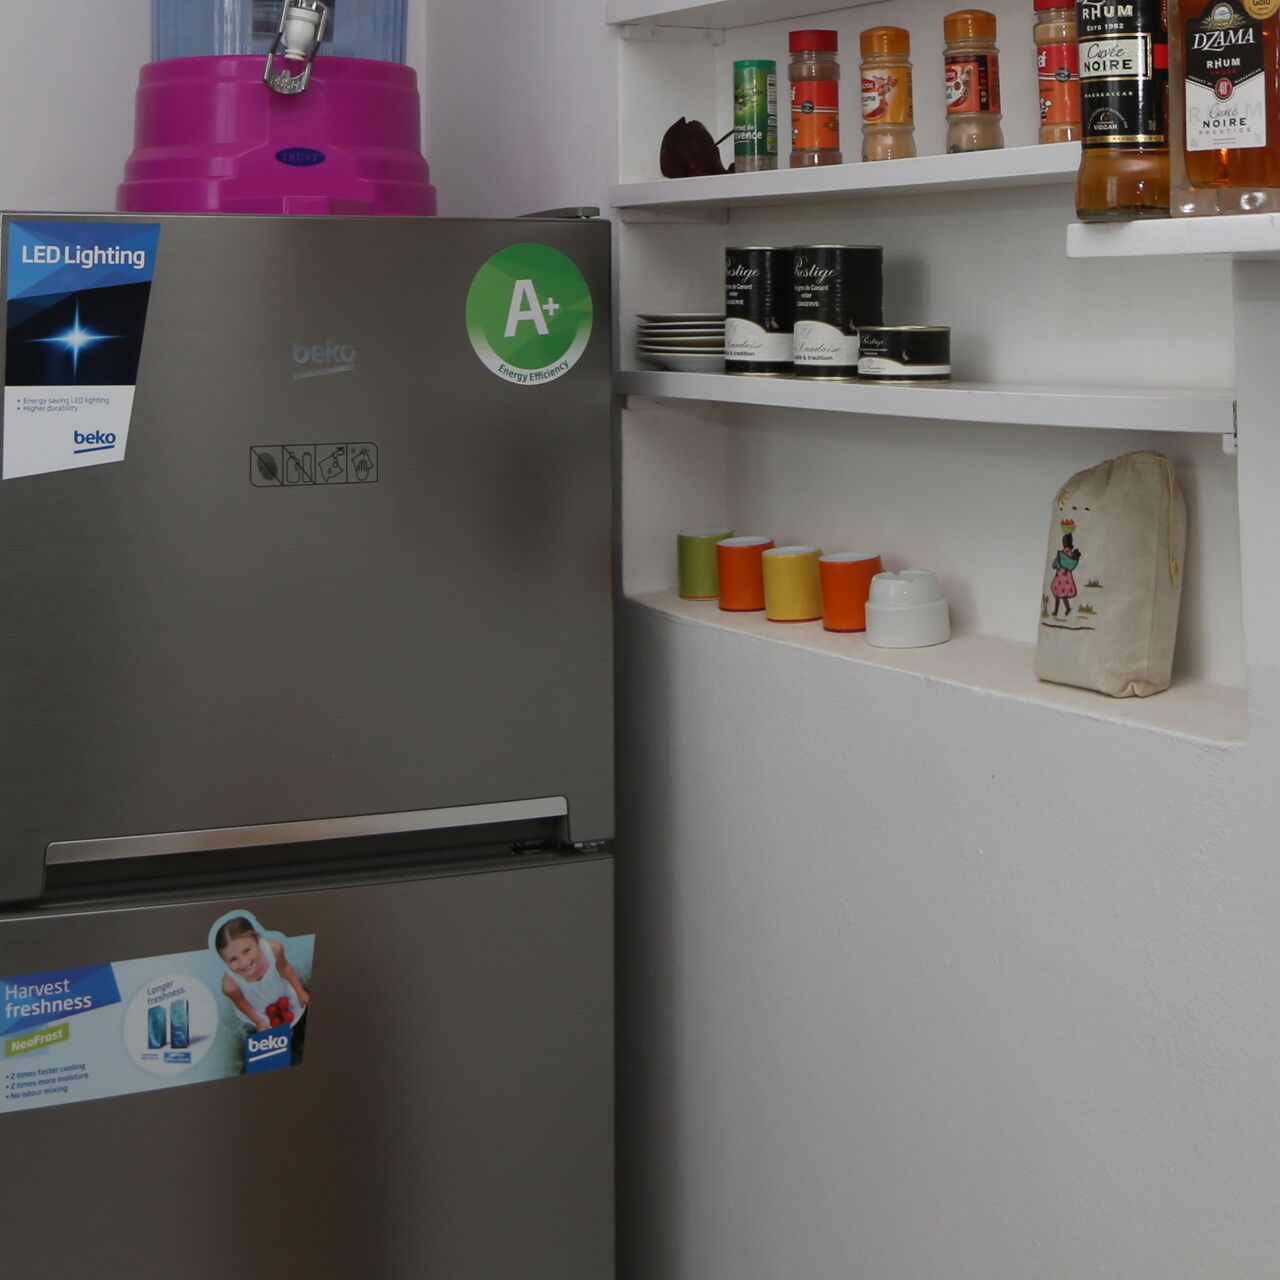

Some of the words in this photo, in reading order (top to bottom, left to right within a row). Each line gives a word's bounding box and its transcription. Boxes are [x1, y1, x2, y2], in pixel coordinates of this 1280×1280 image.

[1082, 3, 1134, 20] RHUM
[1105, 22, 1125, 31] 1982
[1192, 28, 1255, 51] DZAMA
[1087, 43, 1125, 59] Cuvée
[1084, 58, 1133, 72] NOIRE
[1206, 58, 1241, 70] RHUM
[1199, 127, 1252, 136] PRESTIGE
[1203, 118, 1247, 129] NOIRE
[283, 153, 318, 162] TRUST
[21, 245, 61, 264] LED
[64, 245, 145, 269] Lighting
[503, 279, 560, 337] A+
[292, 340, 356, 364] beko
[497, 363, 529, 383] Energy
[529, 359, 570, 382] Efficiency
[23, 405, 45, 413] Higher
[84, 397, 110, 405] lighting
[74, 430, 116, 444] beko
[5, 977, 71, 1001] Harvest
[146, 980, 175, 997] Longer
[5, 994, 92, 1019] freshness
[10, 1028, 64, 1053] NeoFrost
[248, 1034, 288, 1053] beko
[16, 1070, 36, 1079] times
[37, 1067, 59, 1075] faster
[60, 1063, 86, 1071] cooling
[10, 1082, 16, 1090] 2
[37, 1077, 56, 1086] more
[57, 1073, 89, 1082] moisture
[10, 1091, 20, 1099] No
[21, 1089, 42, 1098] odour
[43, 1085, 69, 1095] mixing
